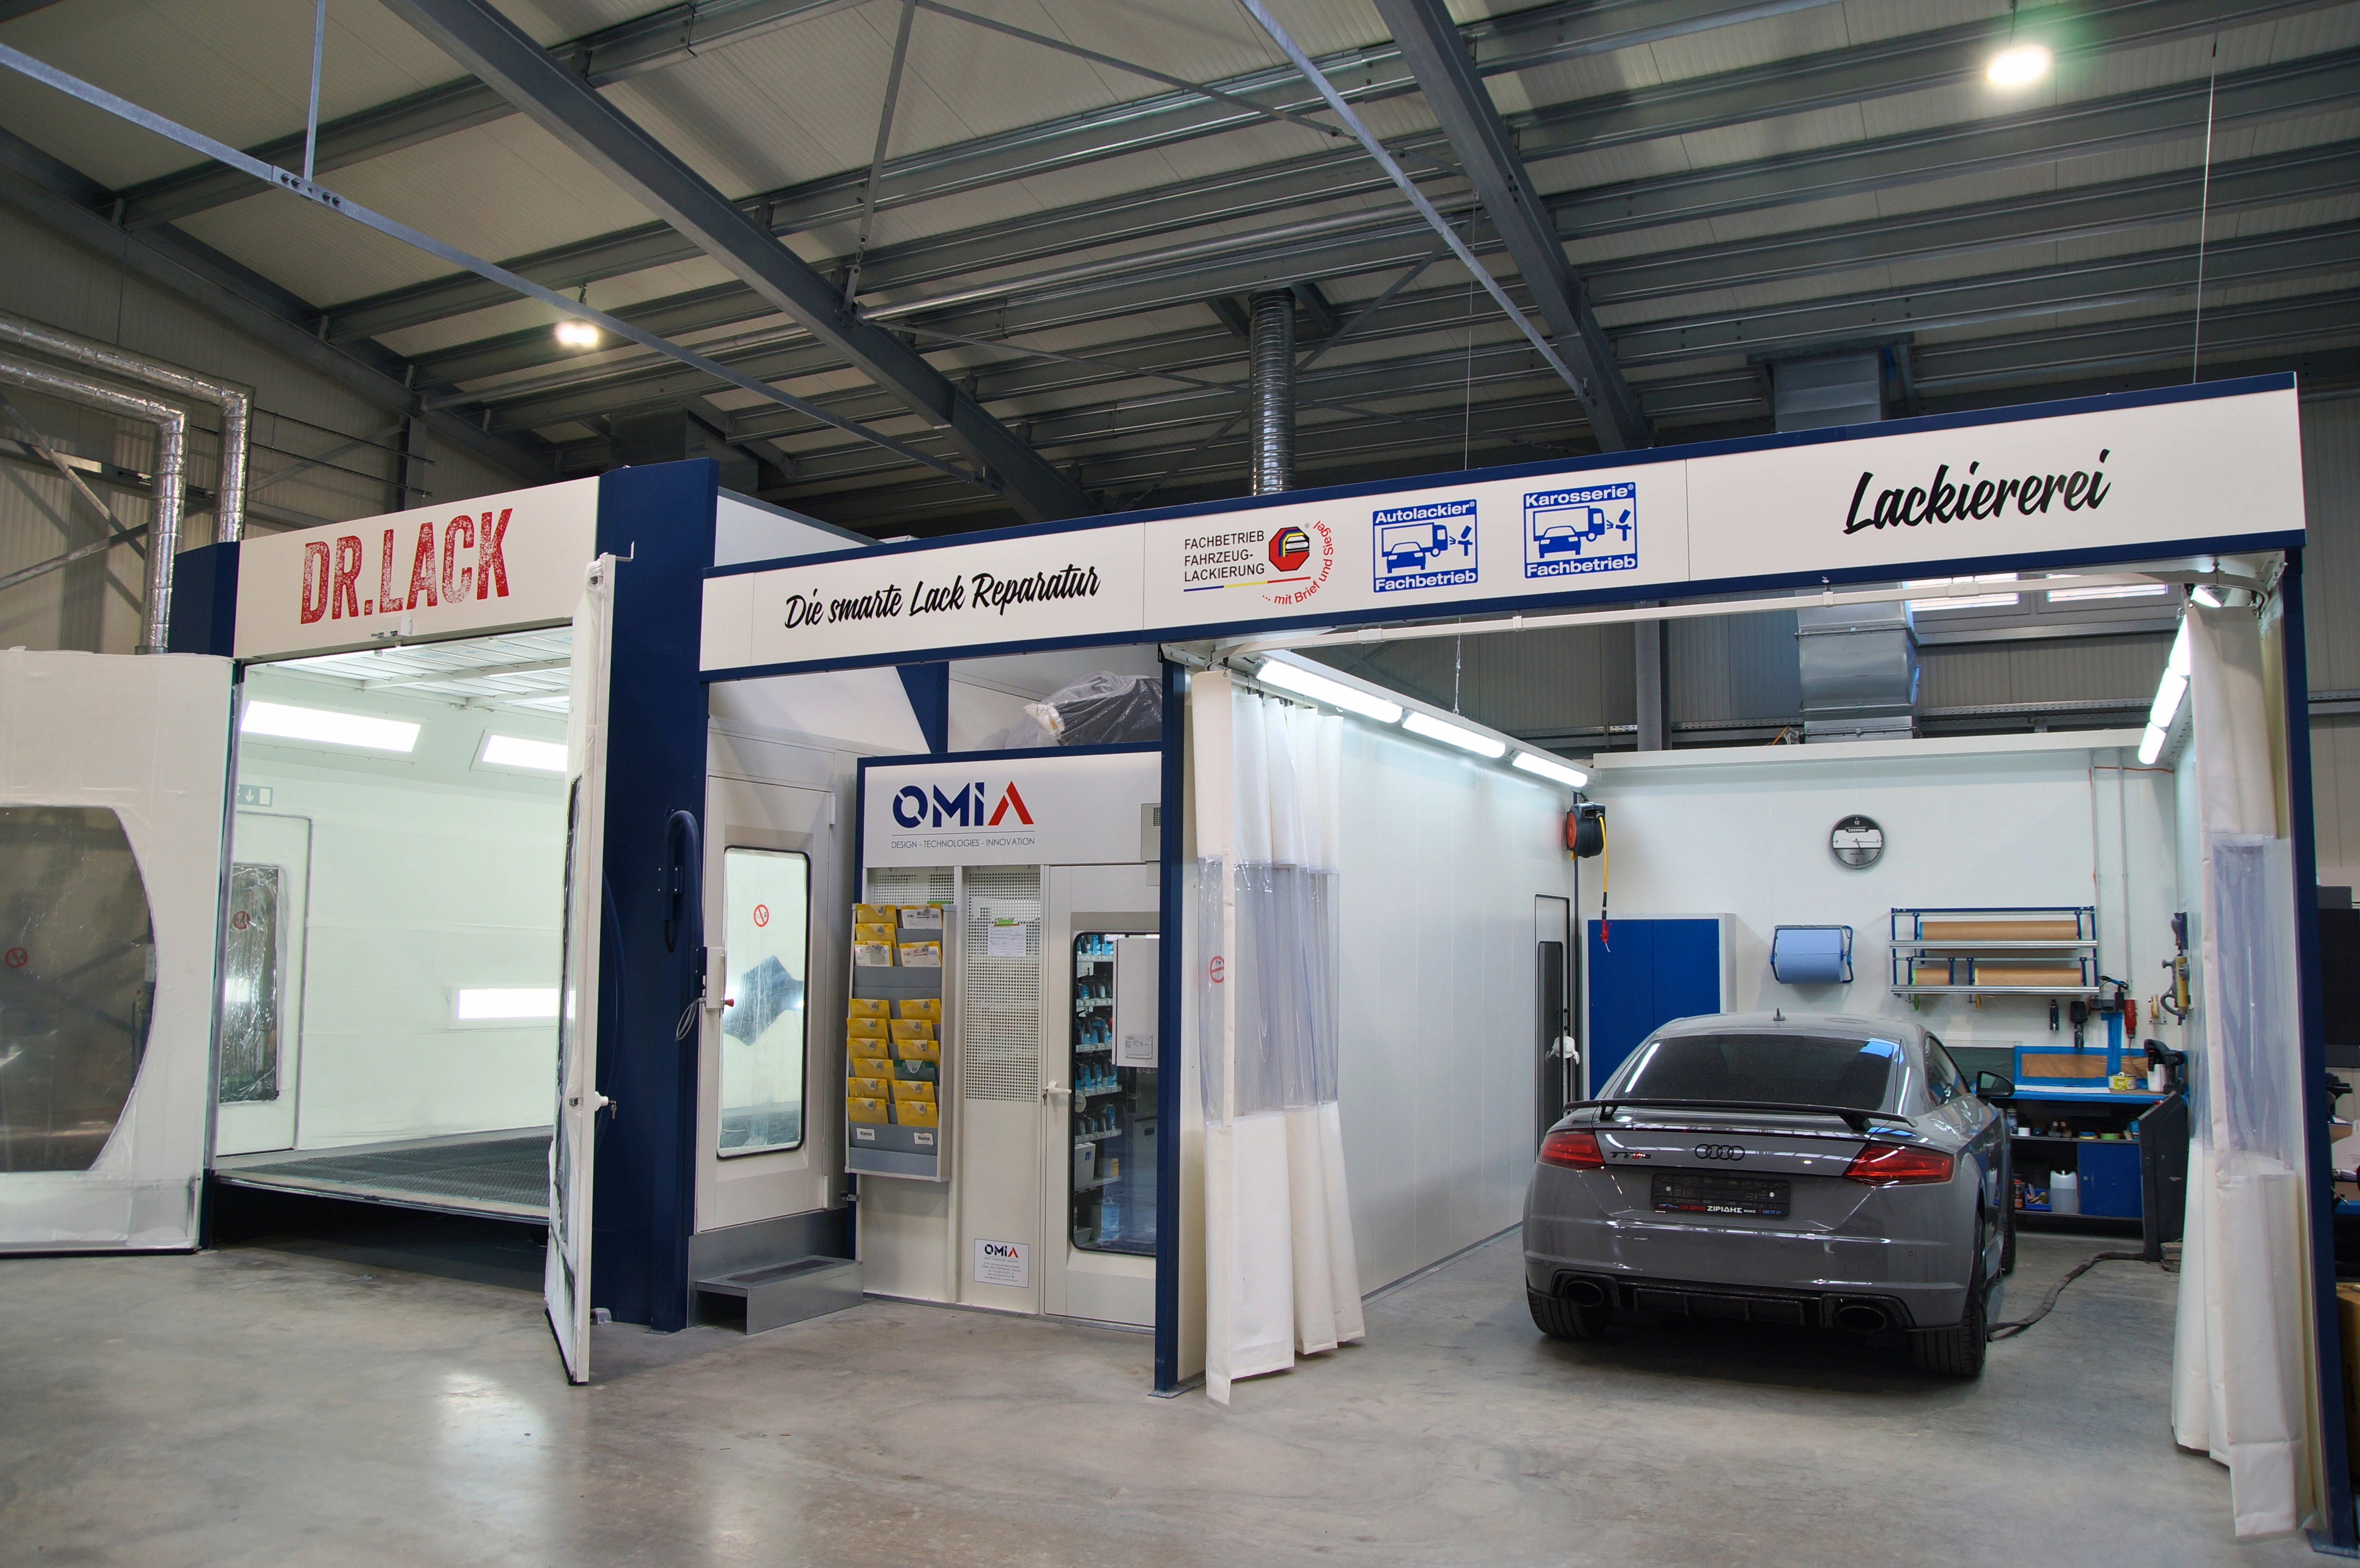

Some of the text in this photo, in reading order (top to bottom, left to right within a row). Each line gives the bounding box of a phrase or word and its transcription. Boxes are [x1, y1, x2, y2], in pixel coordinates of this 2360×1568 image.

[1843, 449, 2111, 534] Lackiererei
[1184, 530, 1265, 550] FACHBETRIEB
[1313, 520, 1334, 555] Siegel
[300, 508, 513, 625] DR.LACK
[1184, 549, 1254, 566] FAHRZEUG-
[1526, 556, 1636, 577] Fachbetrieb
[1184, 563, 1265, 582] LACKIERUNG
[1319, 559, 1333, 582] und
[1375, 570, 1476, 591] Fachbetrieb
[784, 564, 1101, 629] Die smarte Lack Reparatur
[1274, 594, 1292, 605] mit
[1294, 580, 1320, 603] Brief
[891, 841, 917, 849] DESIGN
[923, 839, 980, 848] TECHNOLOGIES
[986, 837, 1035, 846] INNOVATION
